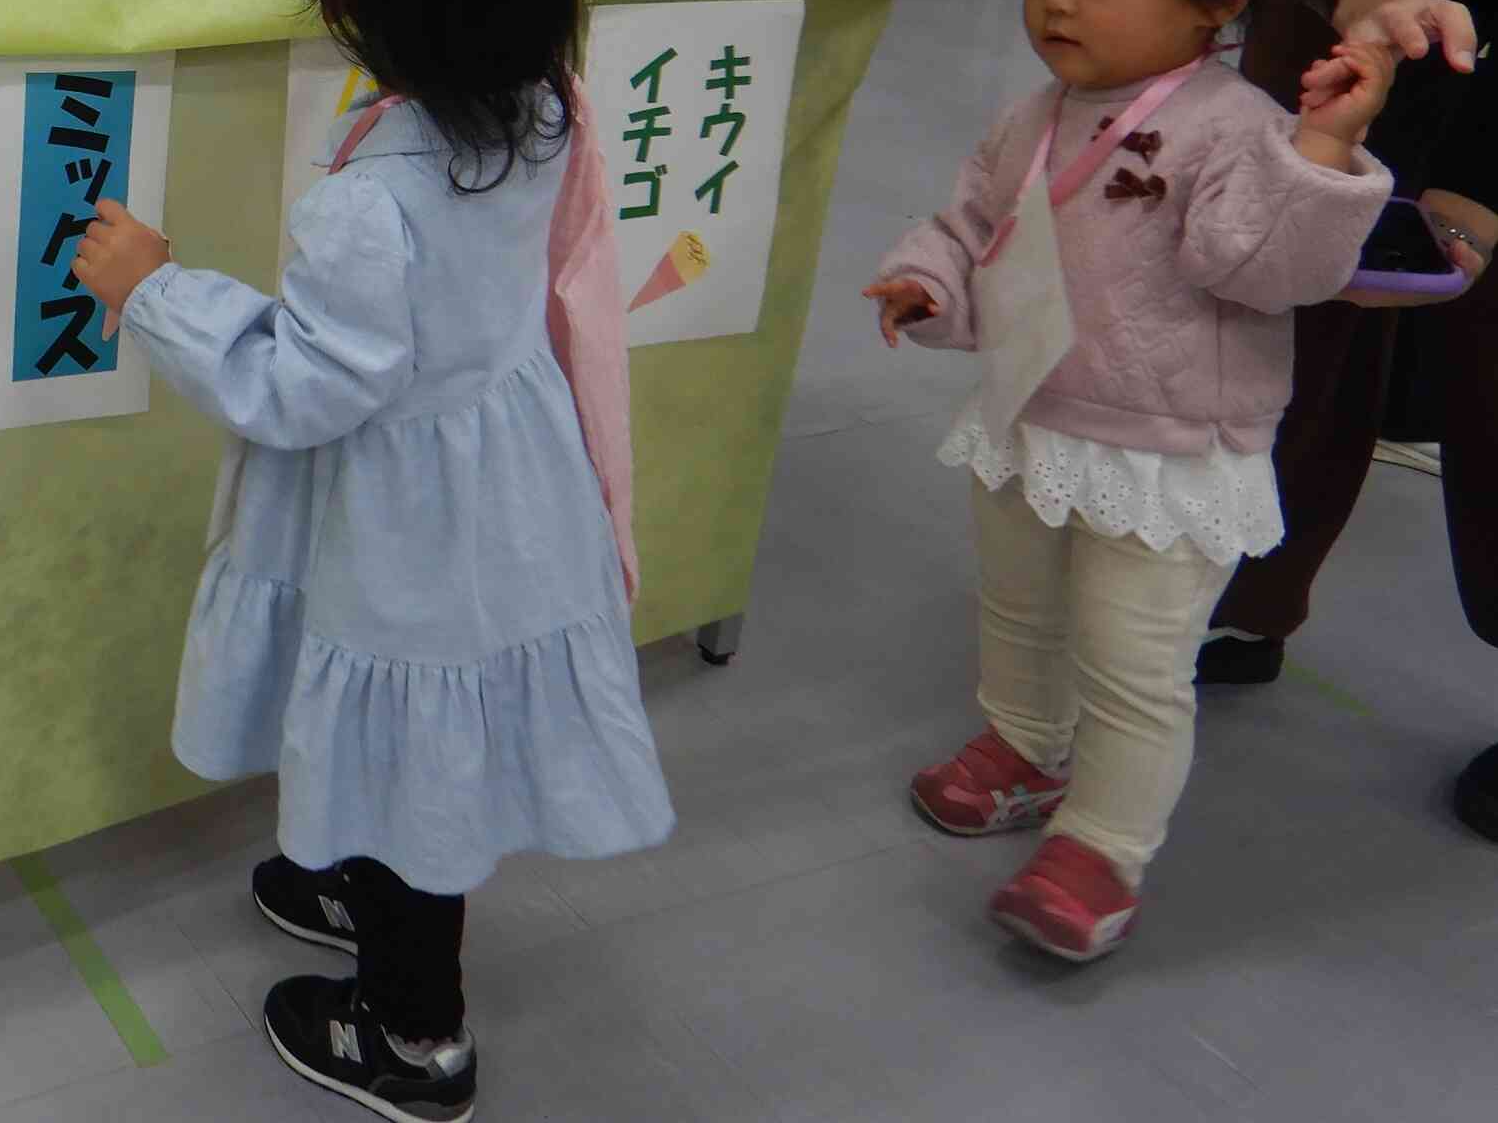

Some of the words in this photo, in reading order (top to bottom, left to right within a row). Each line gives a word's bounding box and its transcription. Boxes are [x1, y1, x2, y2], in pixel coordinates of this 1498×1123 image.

[618, 47, 679, 220] イチゴ
[694, 45, 752, 214] キウイ
